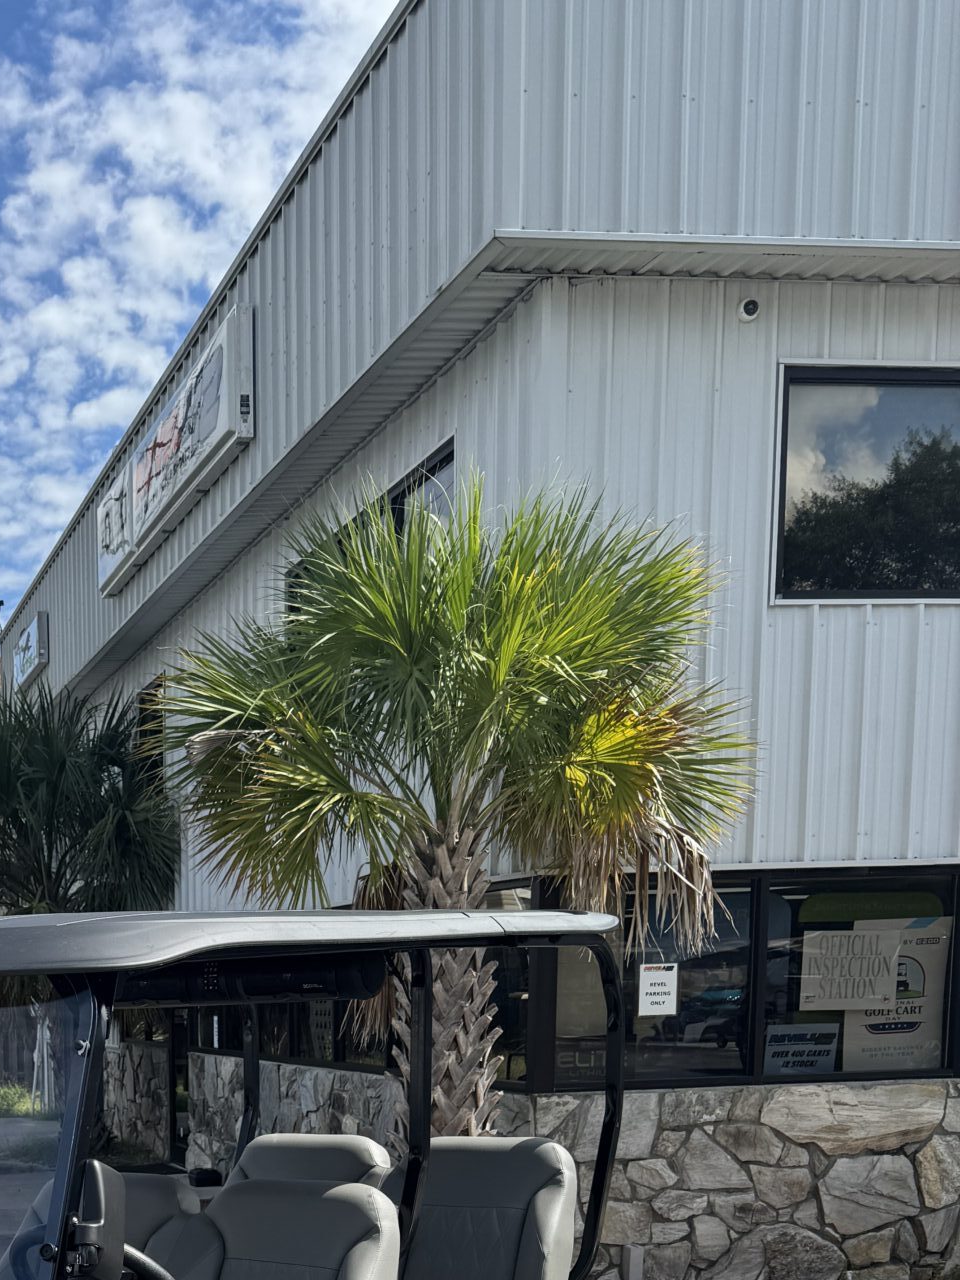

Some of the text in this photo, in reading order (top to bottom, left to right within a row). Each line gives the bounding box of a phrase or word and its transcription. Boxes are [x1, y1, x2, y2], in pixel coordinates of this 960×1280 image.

[819, 934, 882, 956] OFFICIAL
[808, 956, 891, 978] INSPECTION
[818, 977, 878, 999] STATION
[864, 1005, 925, 1017] GOLF CART
[771, 1050, 790, 1058] OVER
[806, 1049, 832, 1057] CARTS
